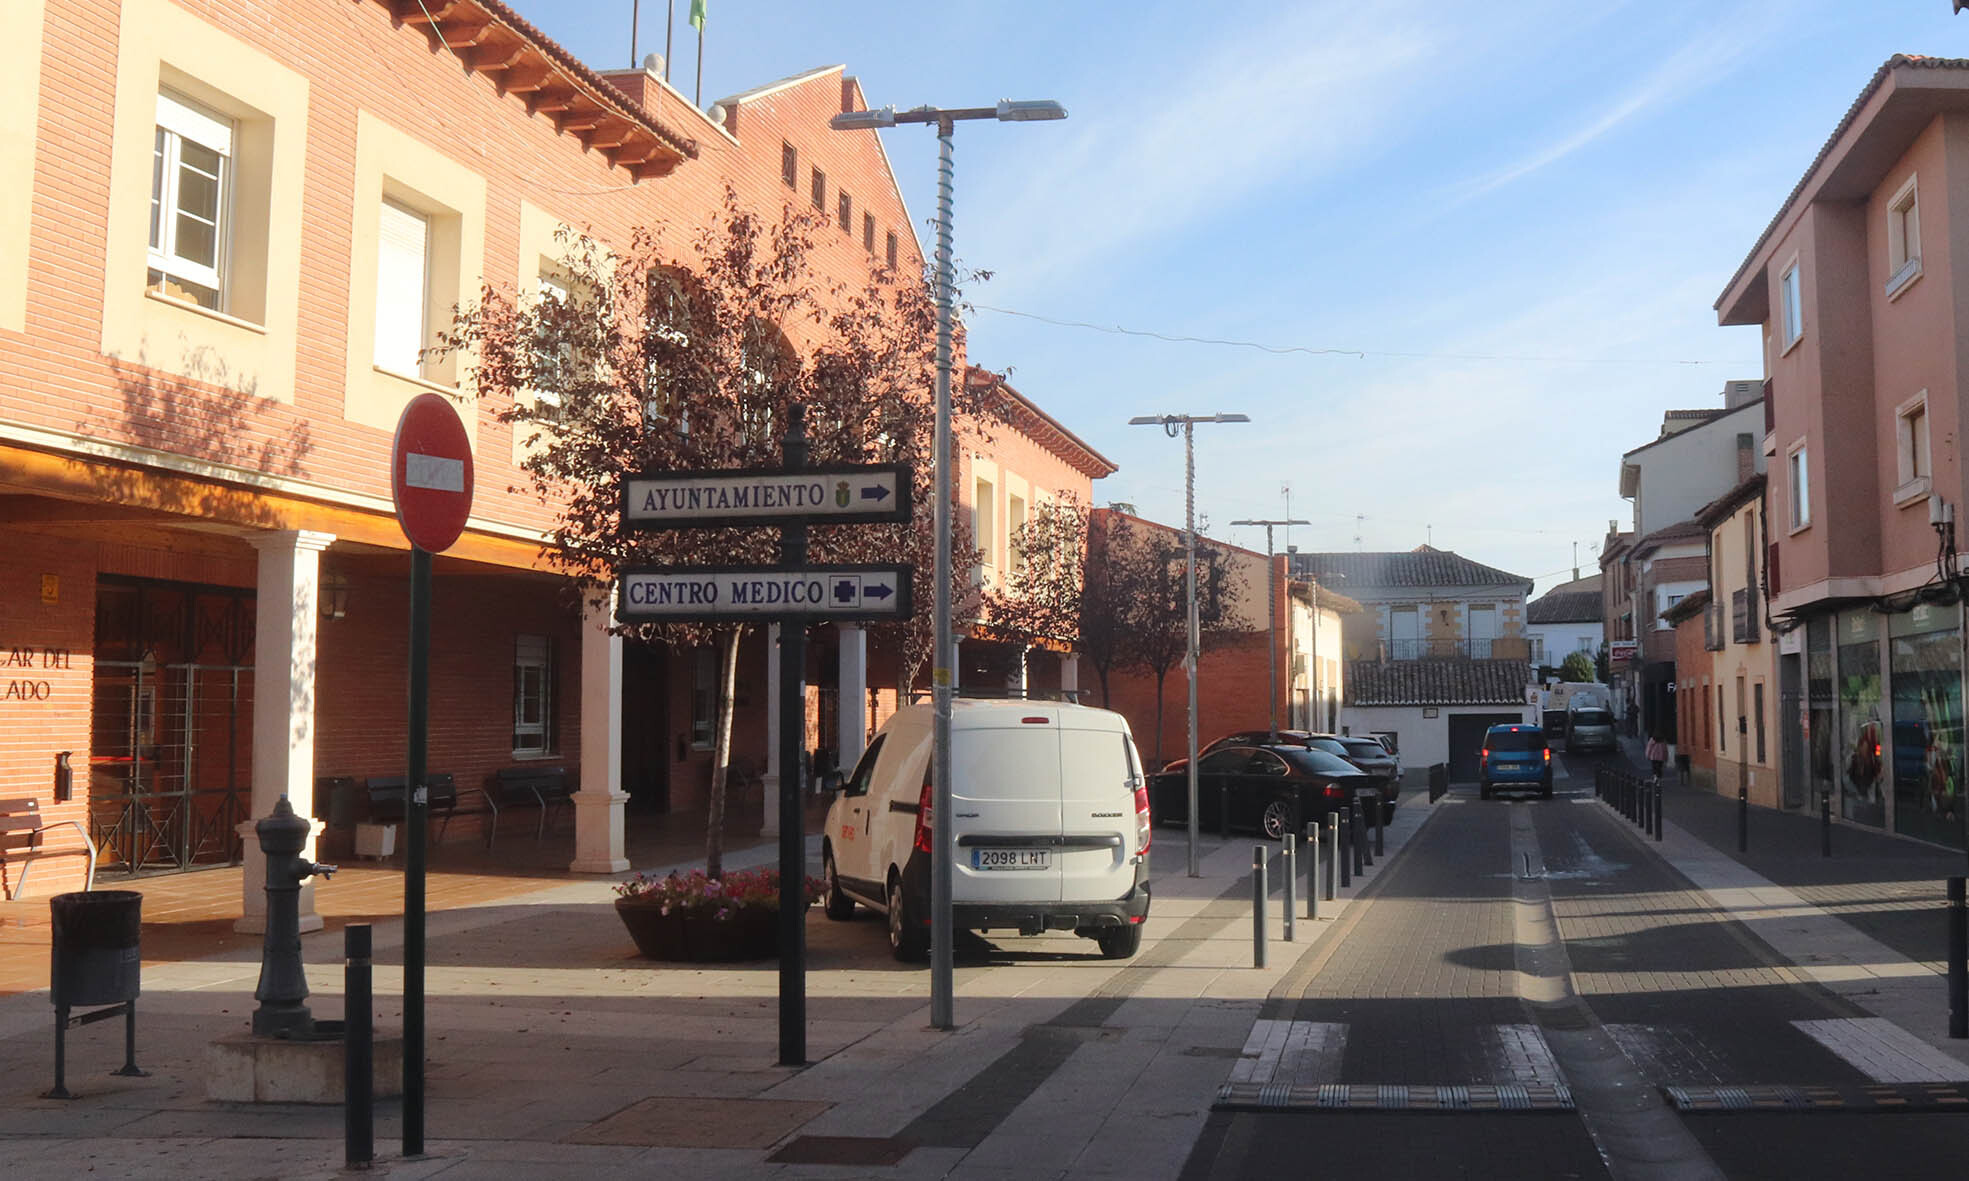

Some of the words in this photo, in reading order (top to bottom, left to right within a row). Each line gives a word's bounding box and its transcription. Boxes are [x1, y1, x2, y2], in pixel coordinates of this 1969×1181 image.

[643, 484, 825, 511] AYUNTAMIENTO
[629, 581, 718, 605] CENTRO
[731, 580, 824, 605] MEDICO
[0, 647, 34, 668] AR
[43, 648, 73, 670] DEL
[982, 851, 1017, 865] 2098
[1021, 851, 1047, 865] LNT
